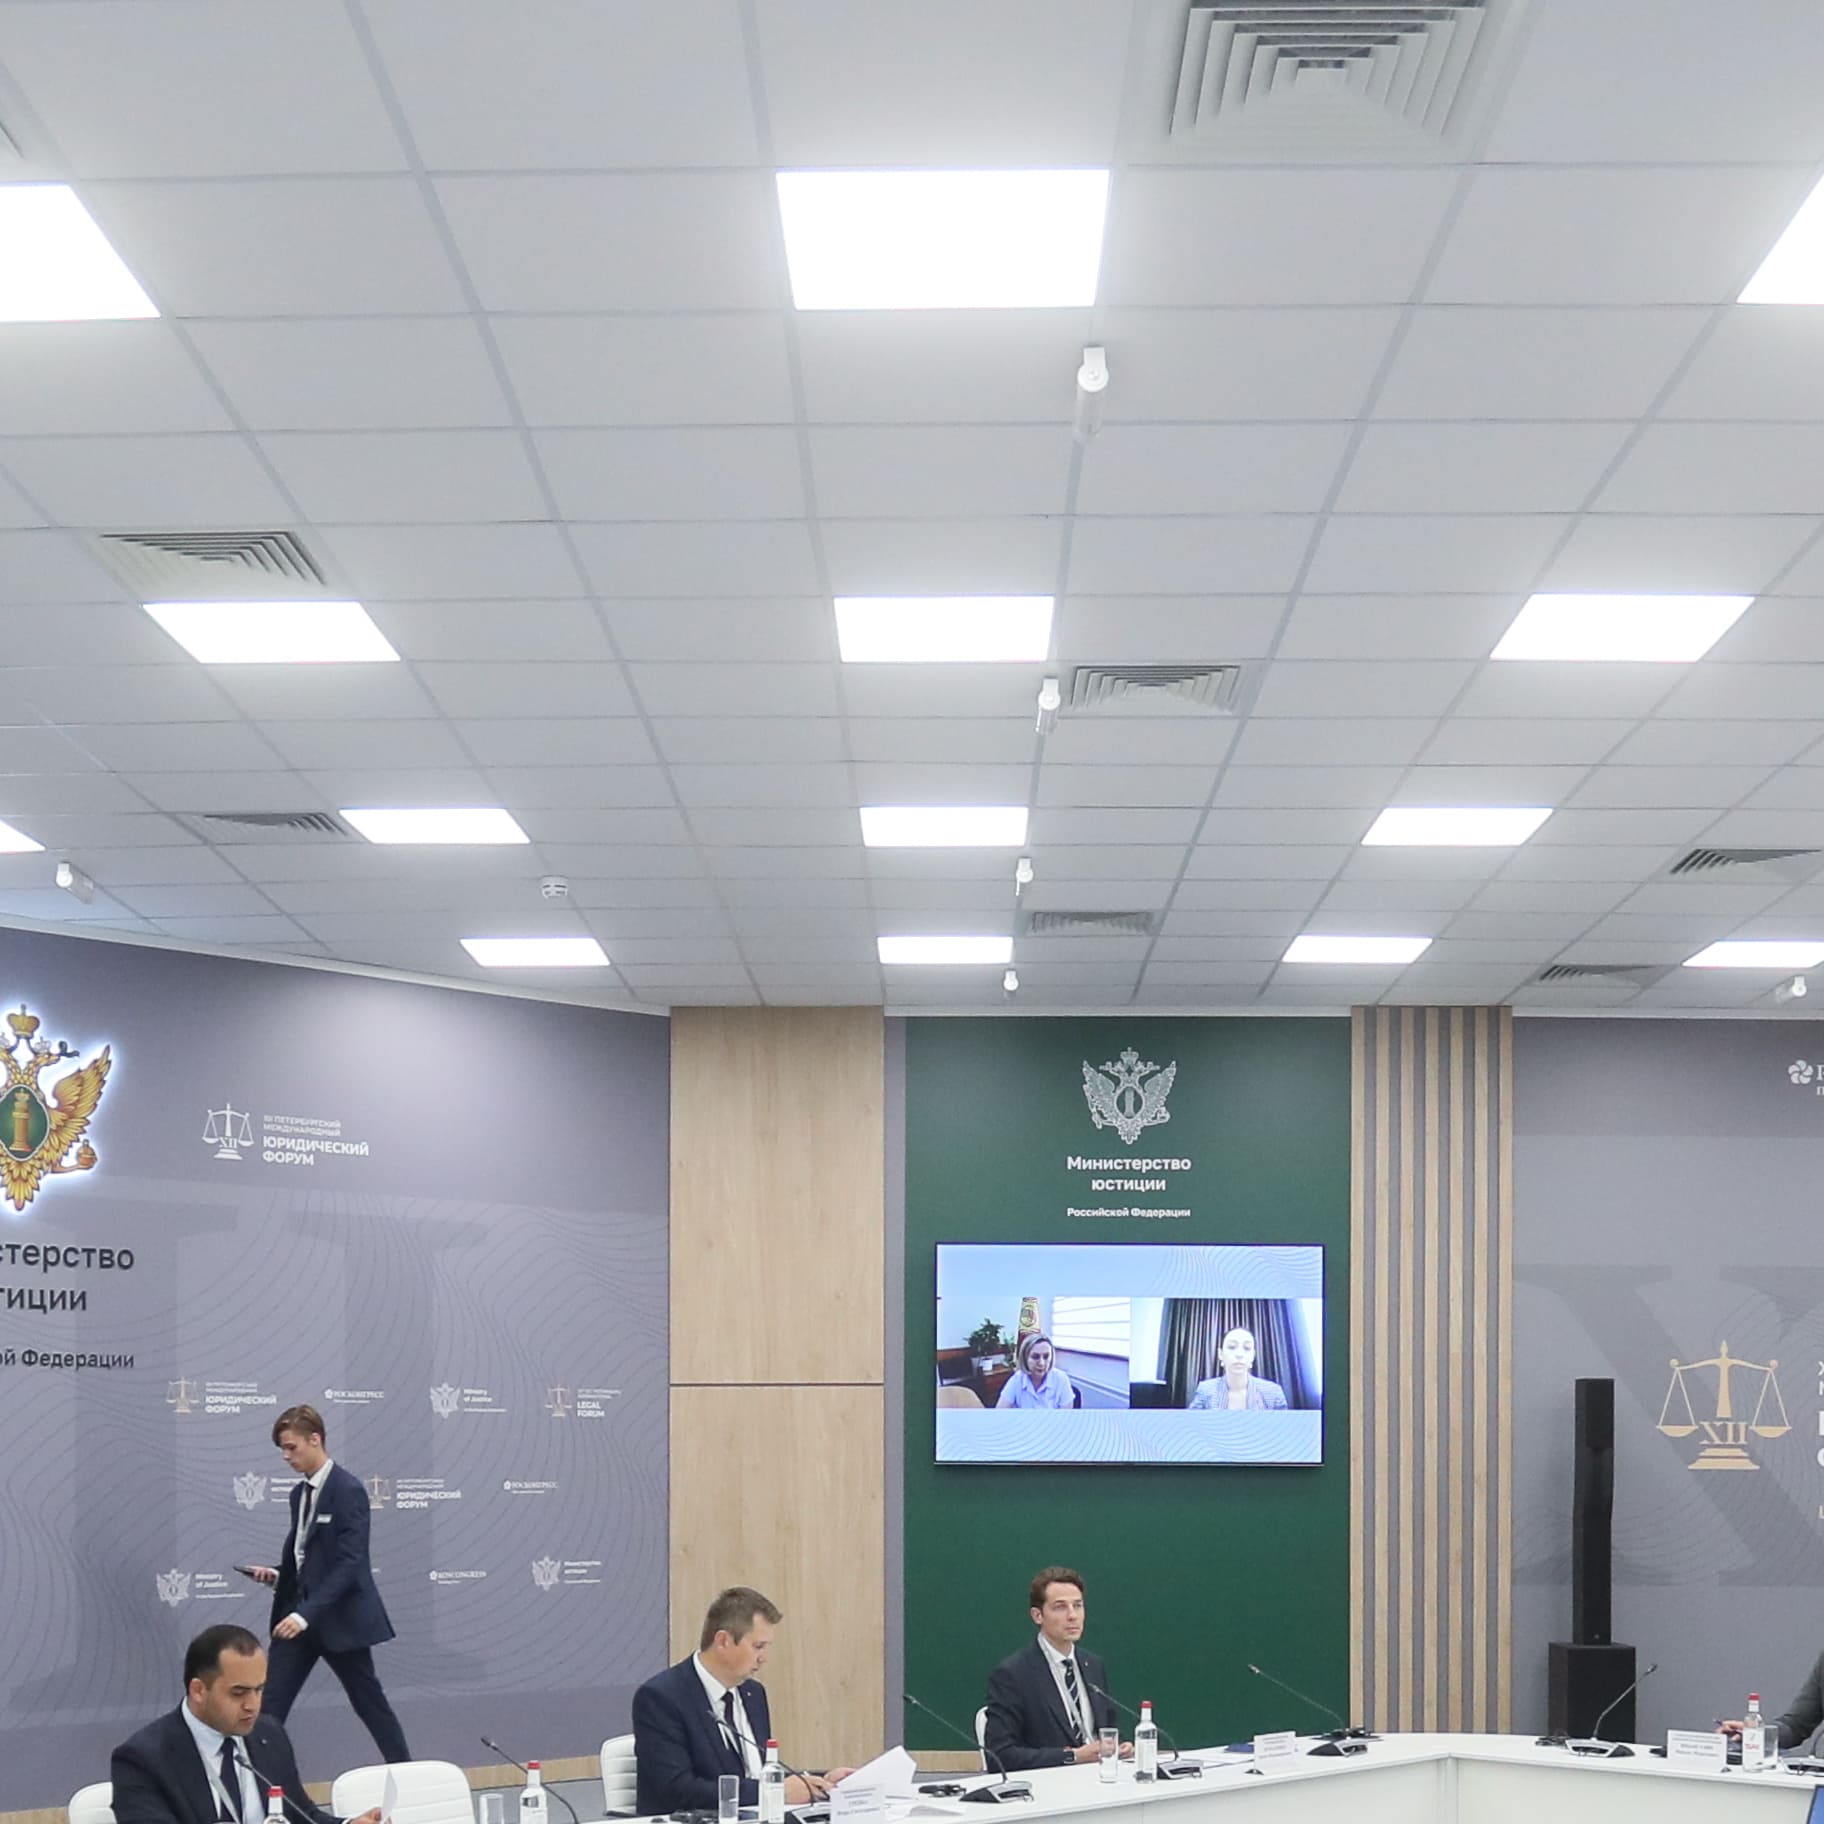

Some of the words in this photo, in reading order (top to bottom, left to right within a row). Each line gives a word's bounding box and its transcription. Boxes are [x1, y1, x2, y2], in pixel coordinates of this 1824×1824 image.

[263, 1135, 369, 1156] ЮРИДИЧЕСКИЙ
[262, 1150, 314, 1166] ФОРУМ
[1067, 1156, 1192, 1173] Министерство
[1091, 1179, 1166, 1192] юстиции
[1067, 1207, 1129, 1217] Российской
[1131, 1207, 1191, 1219] Федерации
[21, 1349, 134, 1370] Федерации
